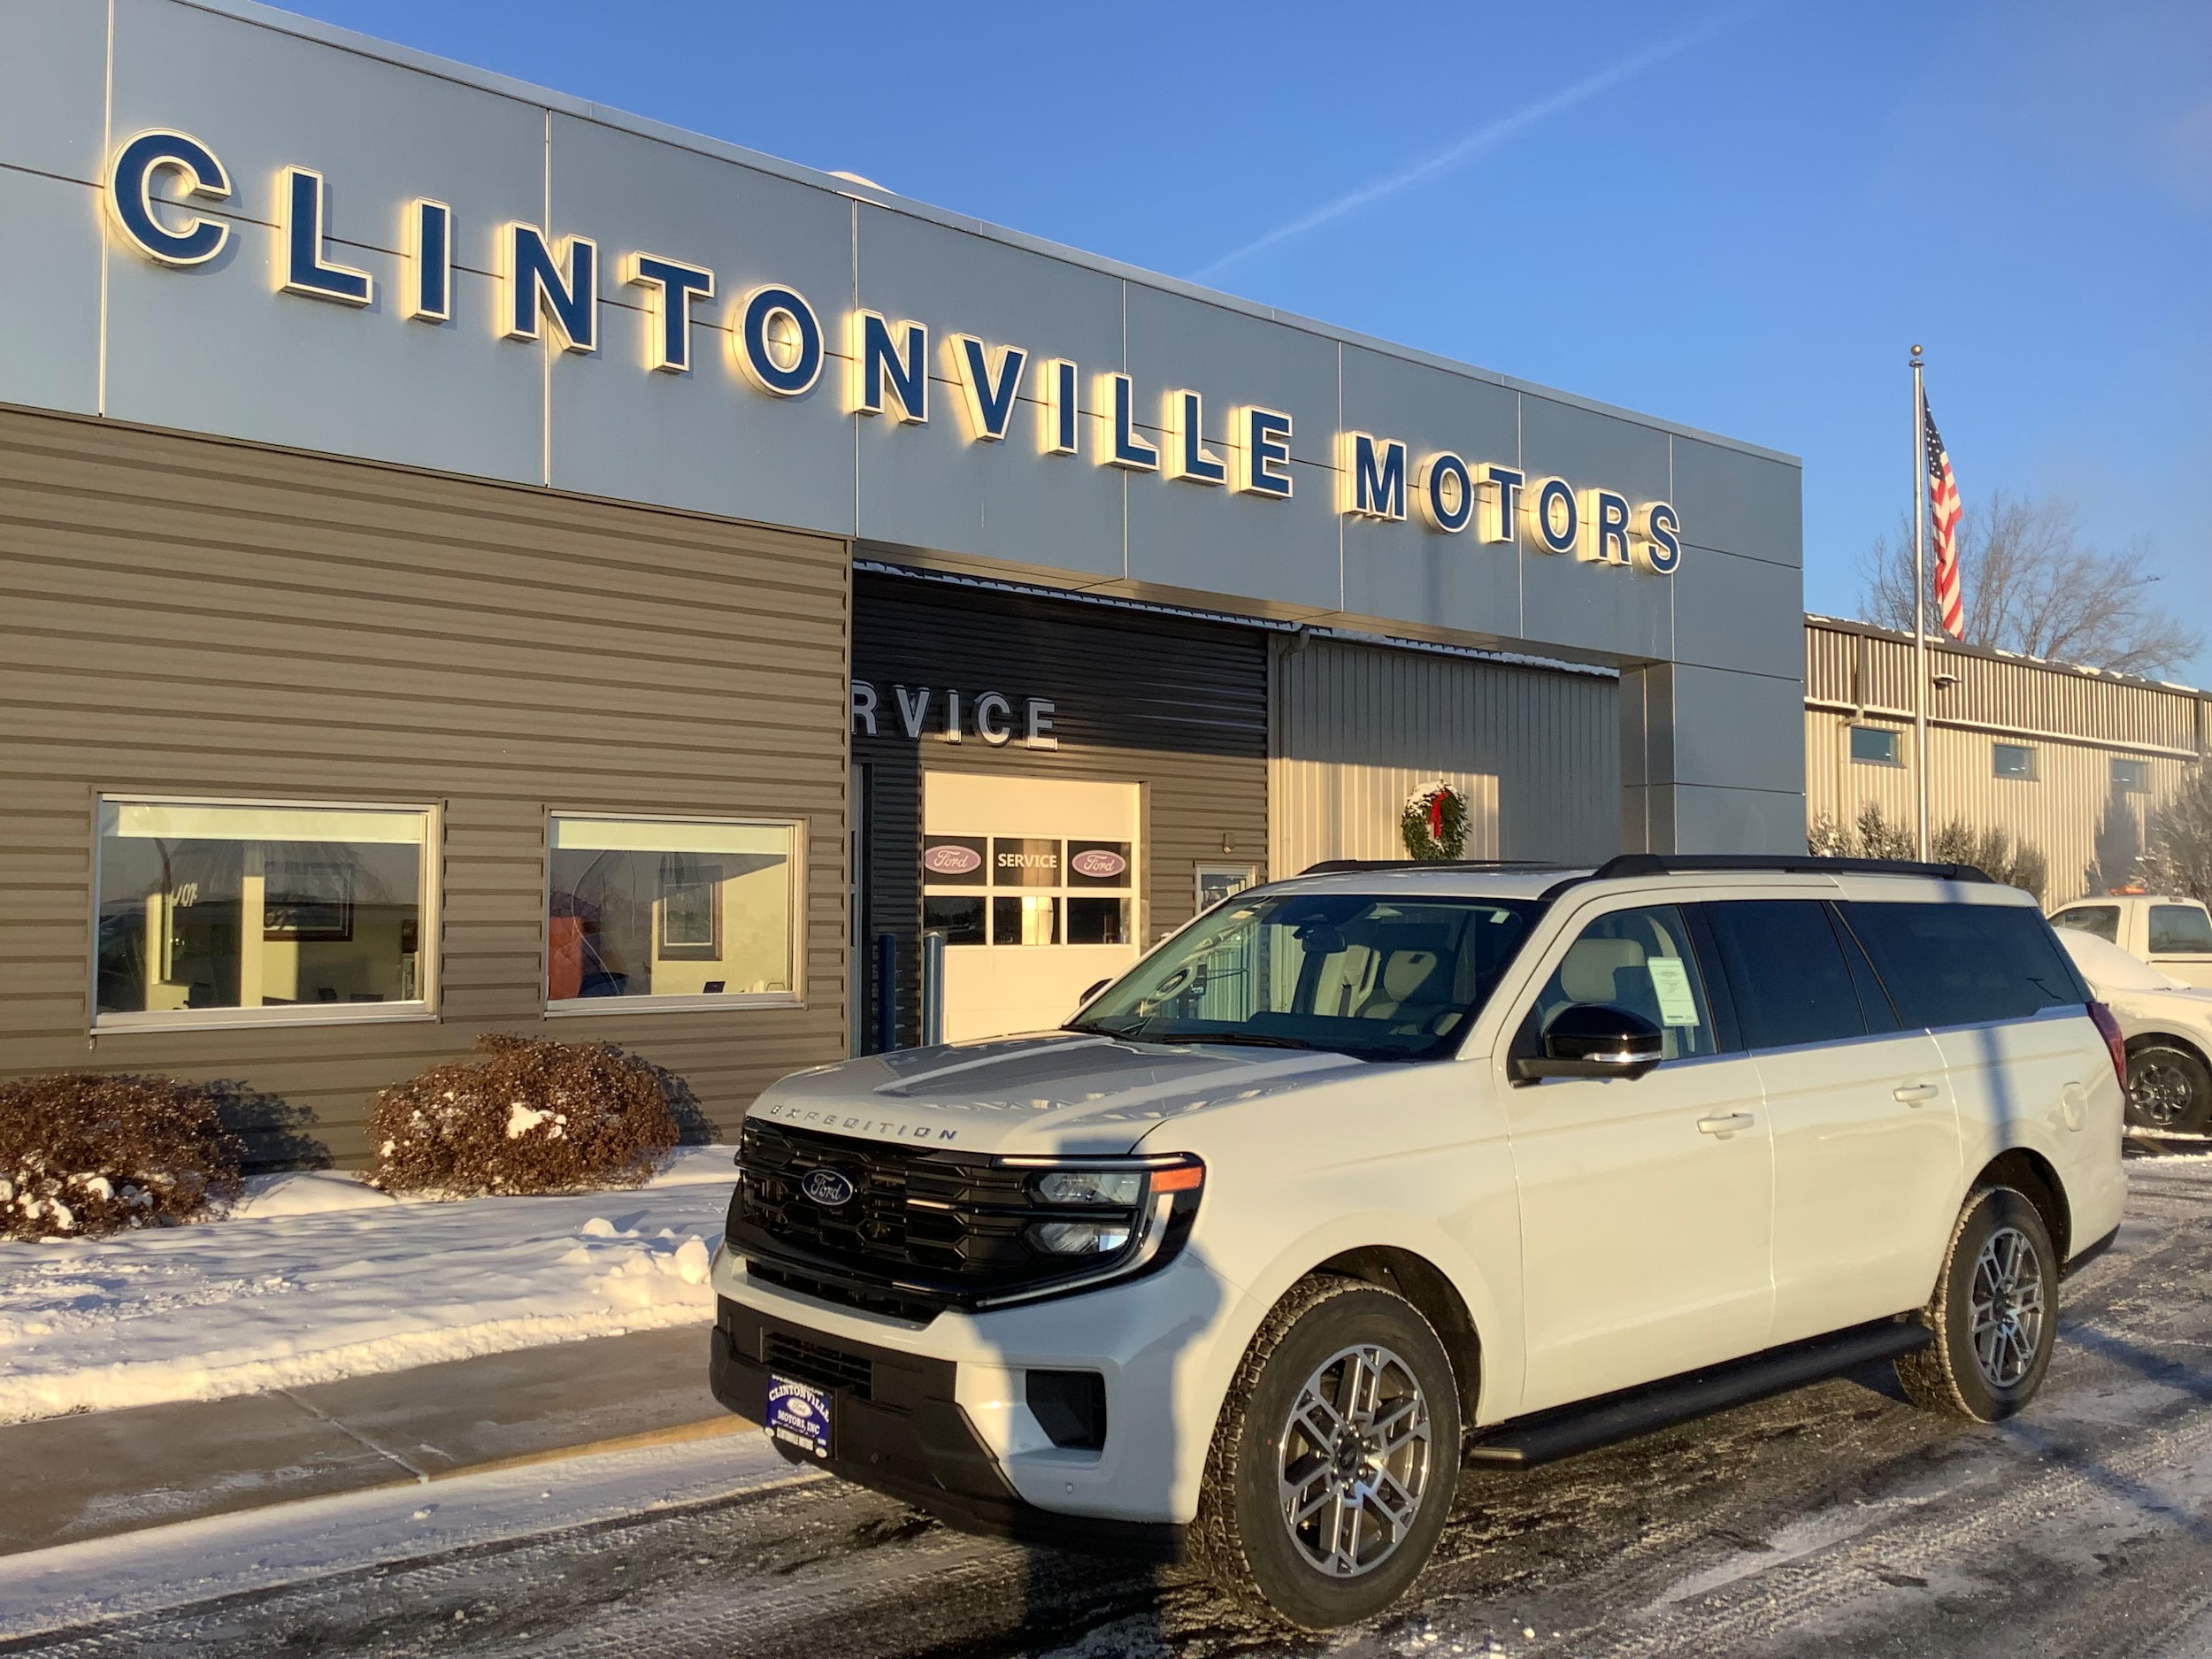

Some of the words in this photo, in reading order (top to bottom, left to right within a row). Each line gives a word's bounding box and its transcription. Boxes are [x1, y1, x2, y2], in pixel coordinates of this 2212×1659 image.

[106, 127, 1294, 500] CLINTONVILLE
[1344, 430, 1681, 575] MOTORS
[933, 849, 969, 868] Ford
[997, 853, 1058, 869] SERVICE
[1083, 855, 1116, 872] Ford
[770, 1105, 958, 1141] EXPEDITION
[810, 1172, 842, 1201] Ford
[768, 1384, 830, 1424] CLINTONVILLE
